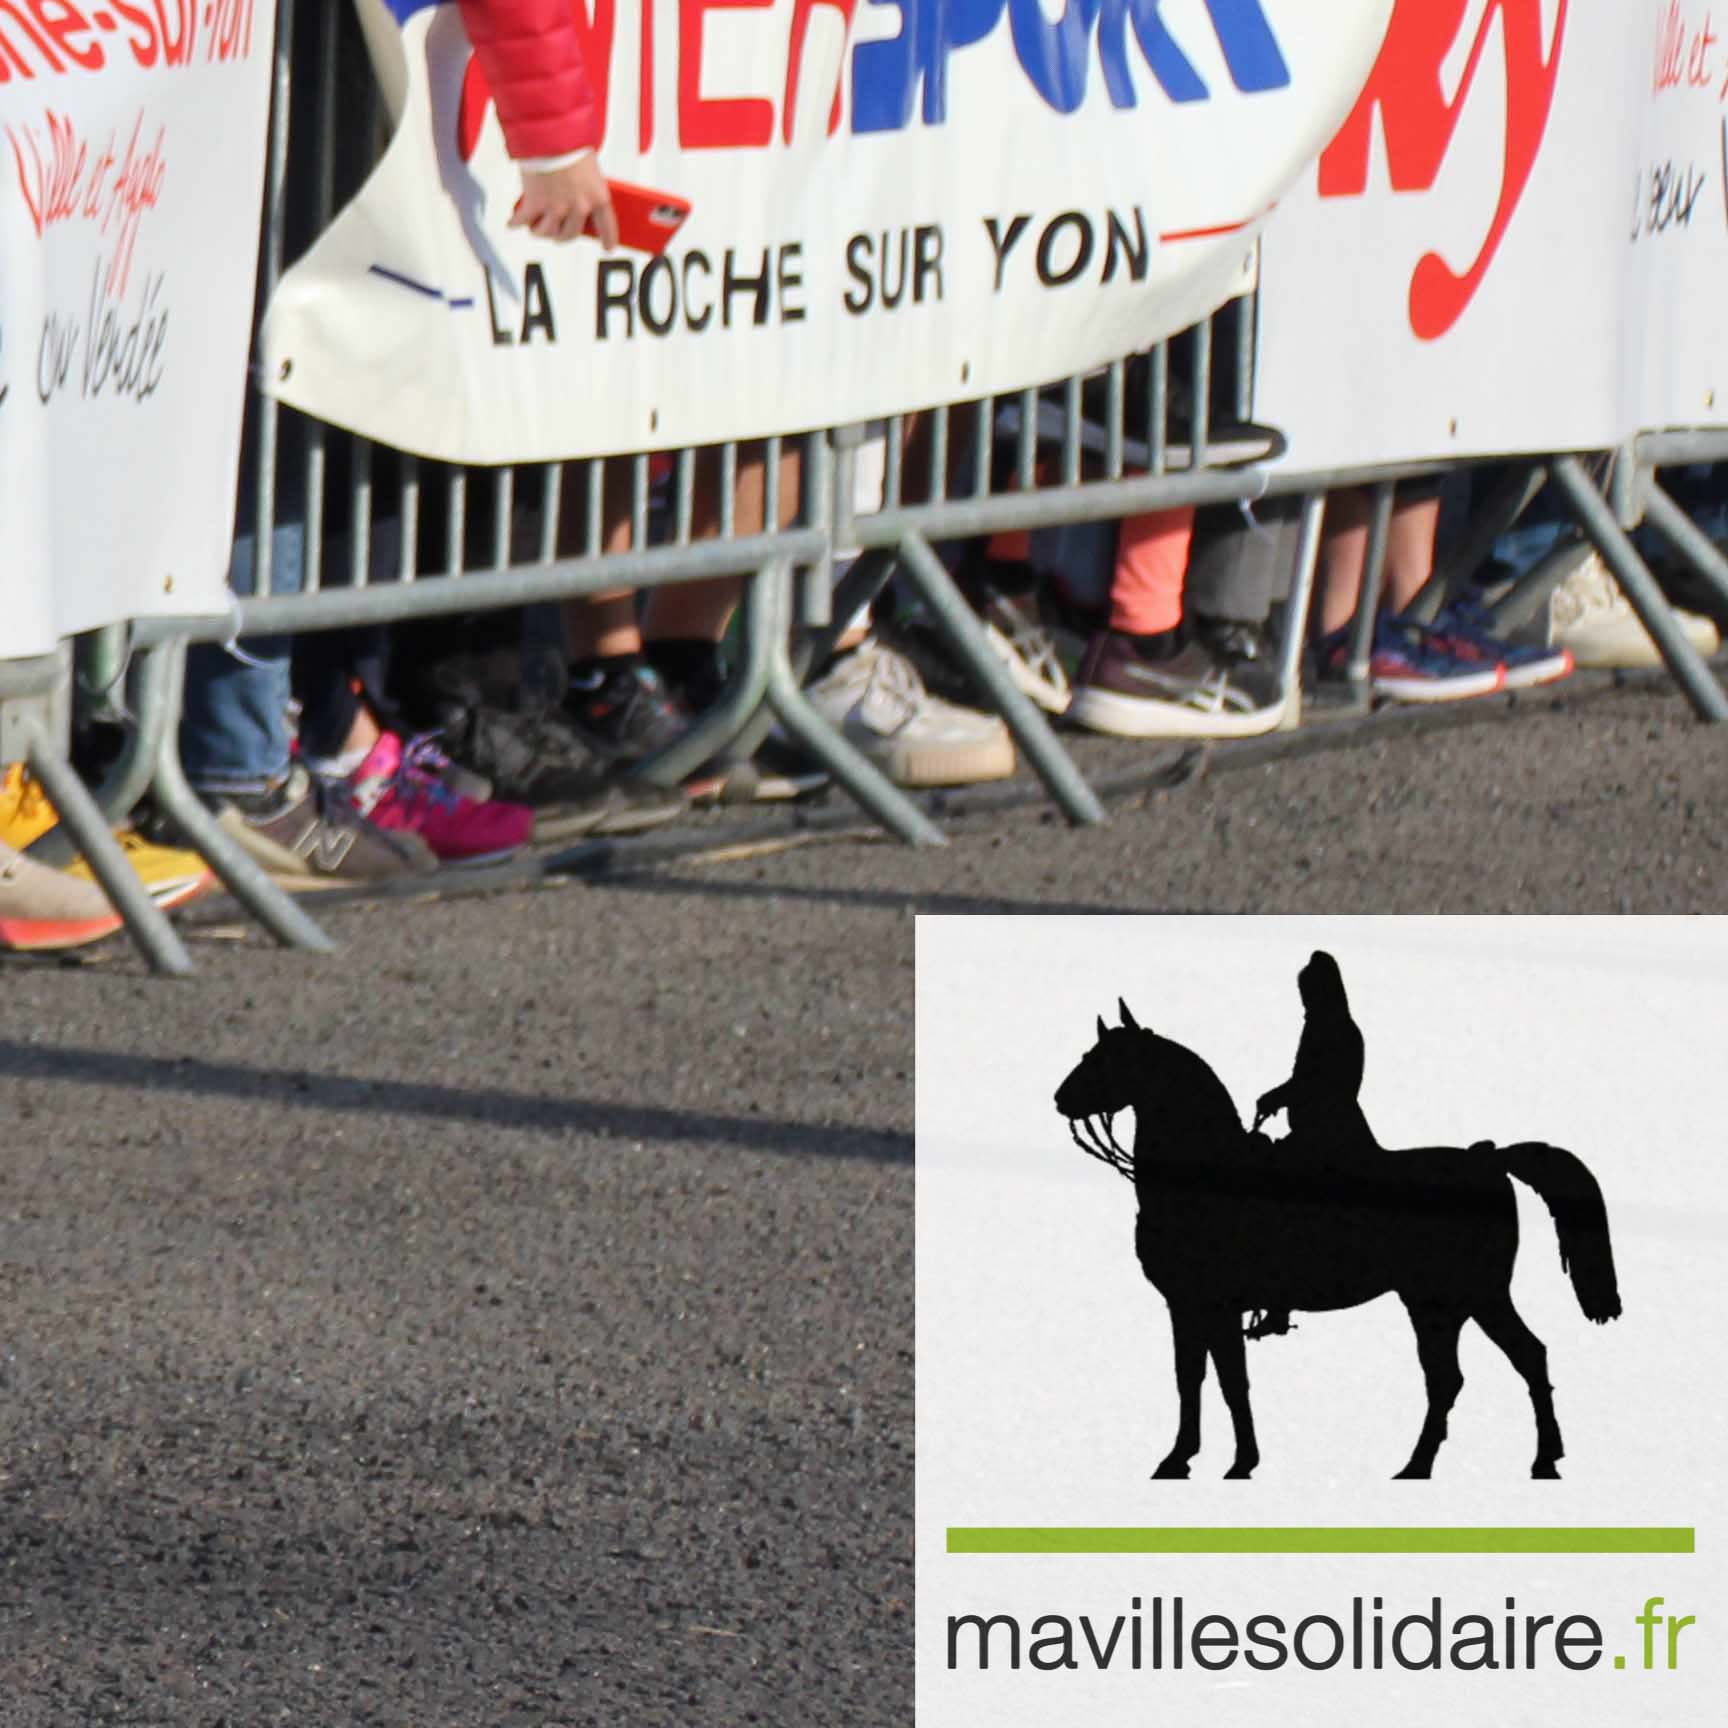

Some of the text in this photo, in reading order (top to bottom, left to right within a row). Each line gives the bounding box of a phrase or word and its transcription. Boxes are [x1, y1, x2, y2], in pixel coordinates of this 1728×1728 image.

[485, 205, 1149, 346] LA ROCHE SUR YON
